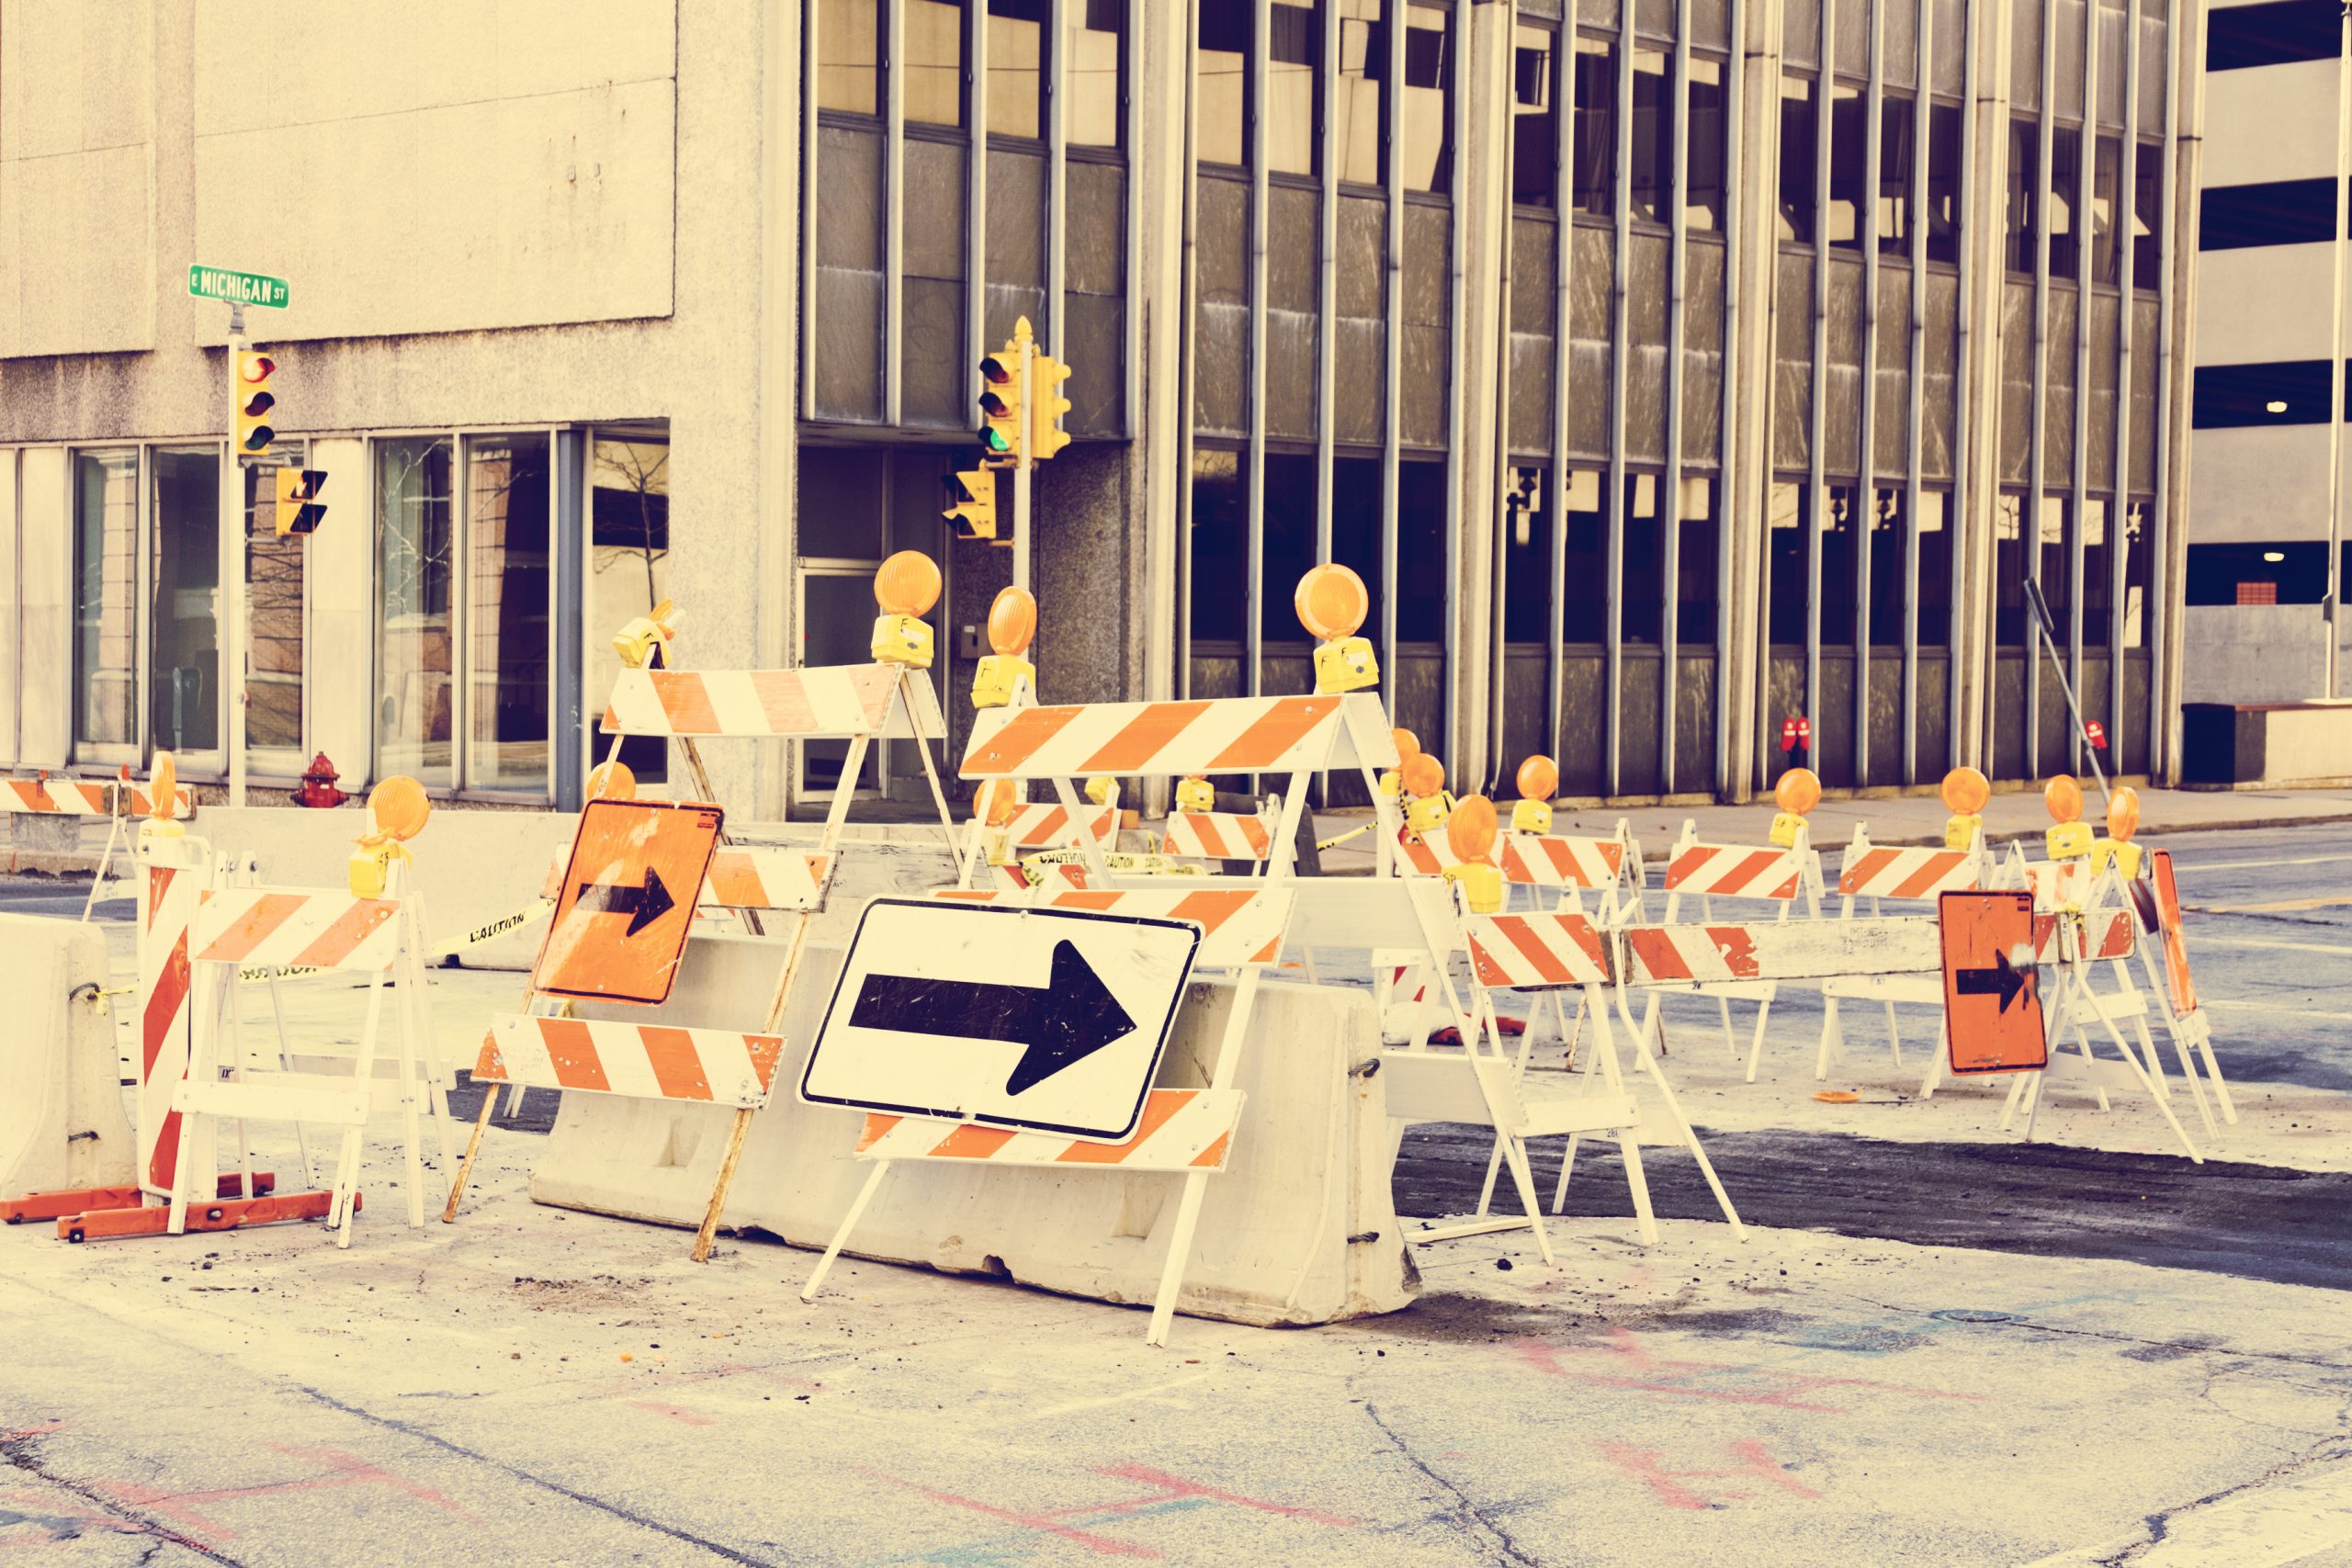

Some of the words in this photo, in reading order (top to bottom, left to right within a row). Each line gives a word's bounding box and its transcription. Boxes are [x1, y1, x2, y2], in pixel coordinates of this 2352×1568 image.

[191, 274, 198, 288] E
[200, 269, 273, 304] MICHIGAN
[273, 287, 287, 301] ST
[1038, 852, 1086, 866] CAUTION
[1105, 854, 1134, 869] CAUTION
[469, 911, 526, 942] CAUTION
